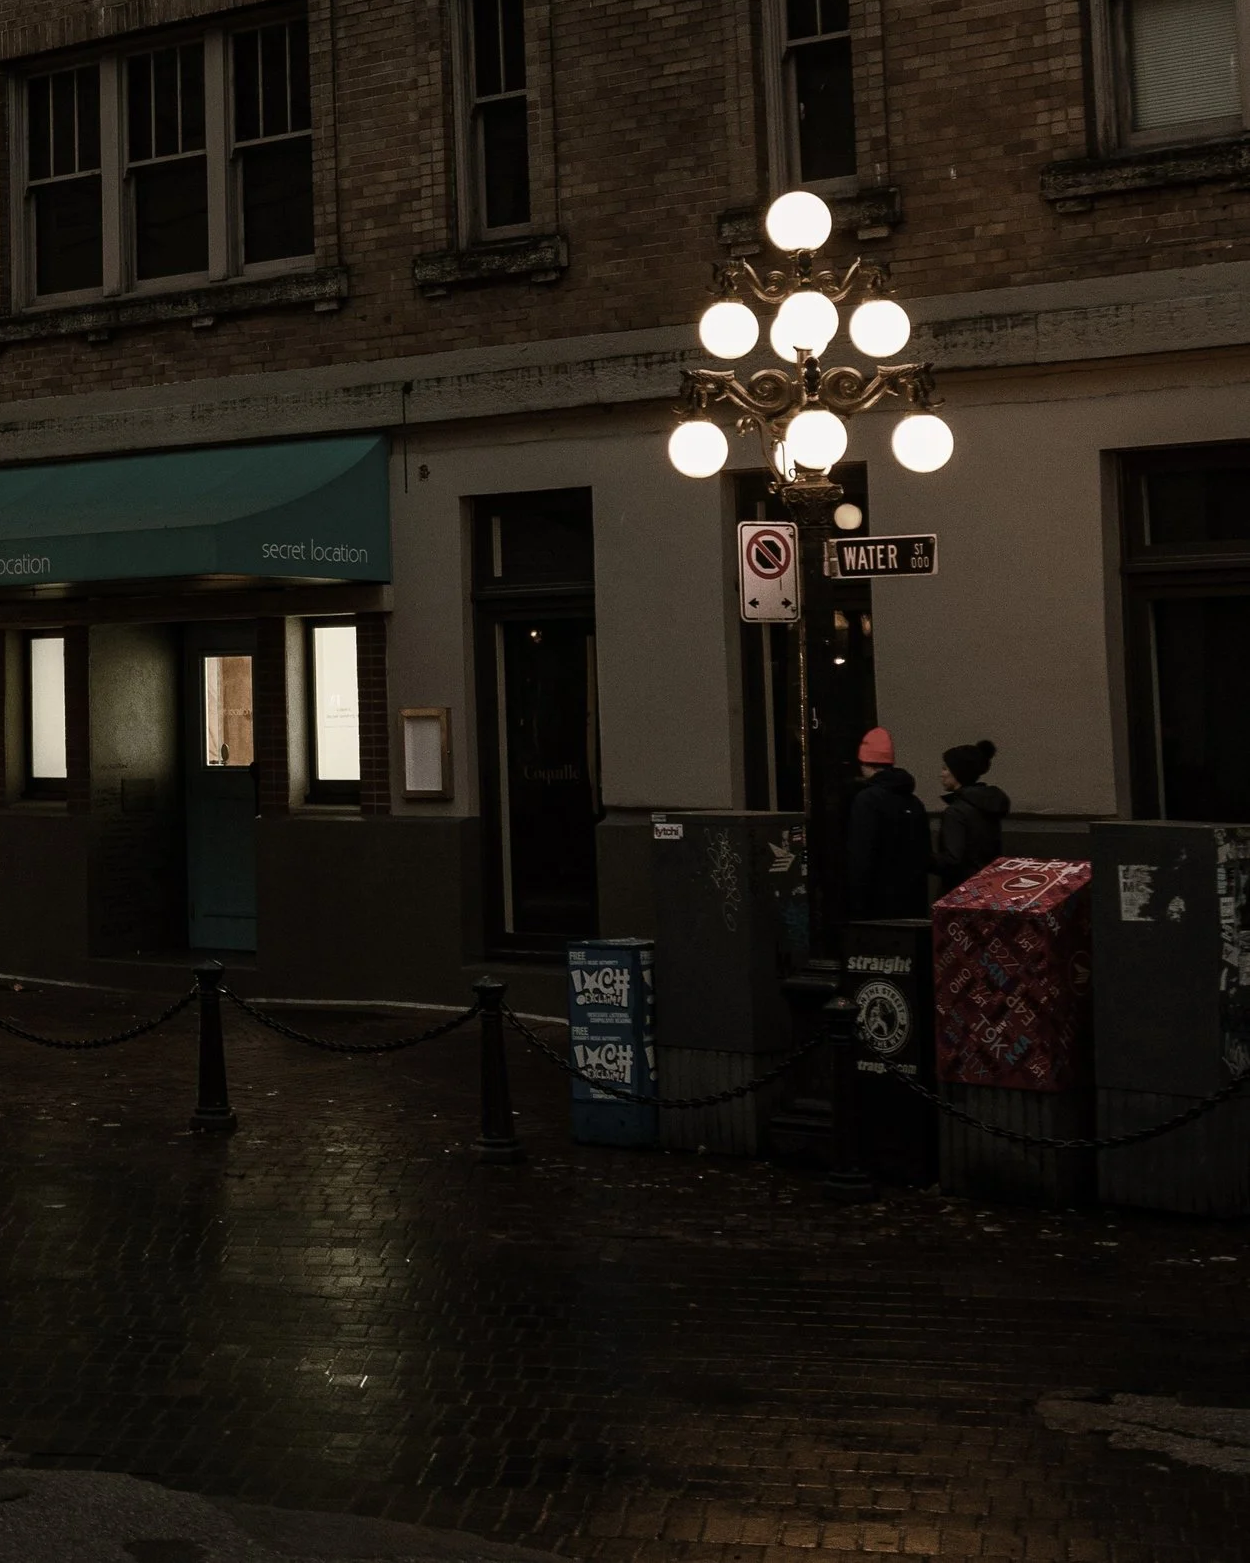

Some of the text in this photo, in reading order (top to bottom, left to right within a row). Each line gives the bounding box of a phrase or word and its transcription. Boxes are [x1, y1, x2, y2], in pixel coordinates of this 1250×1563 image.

[262, 538, 368, 563] secret location
[843, 543, 924, 570] WATER ST
[569, 951, 587, 961] FREE
[847, 955, 913, 974] straight
[572, 1026, 590, 1037] FREE
